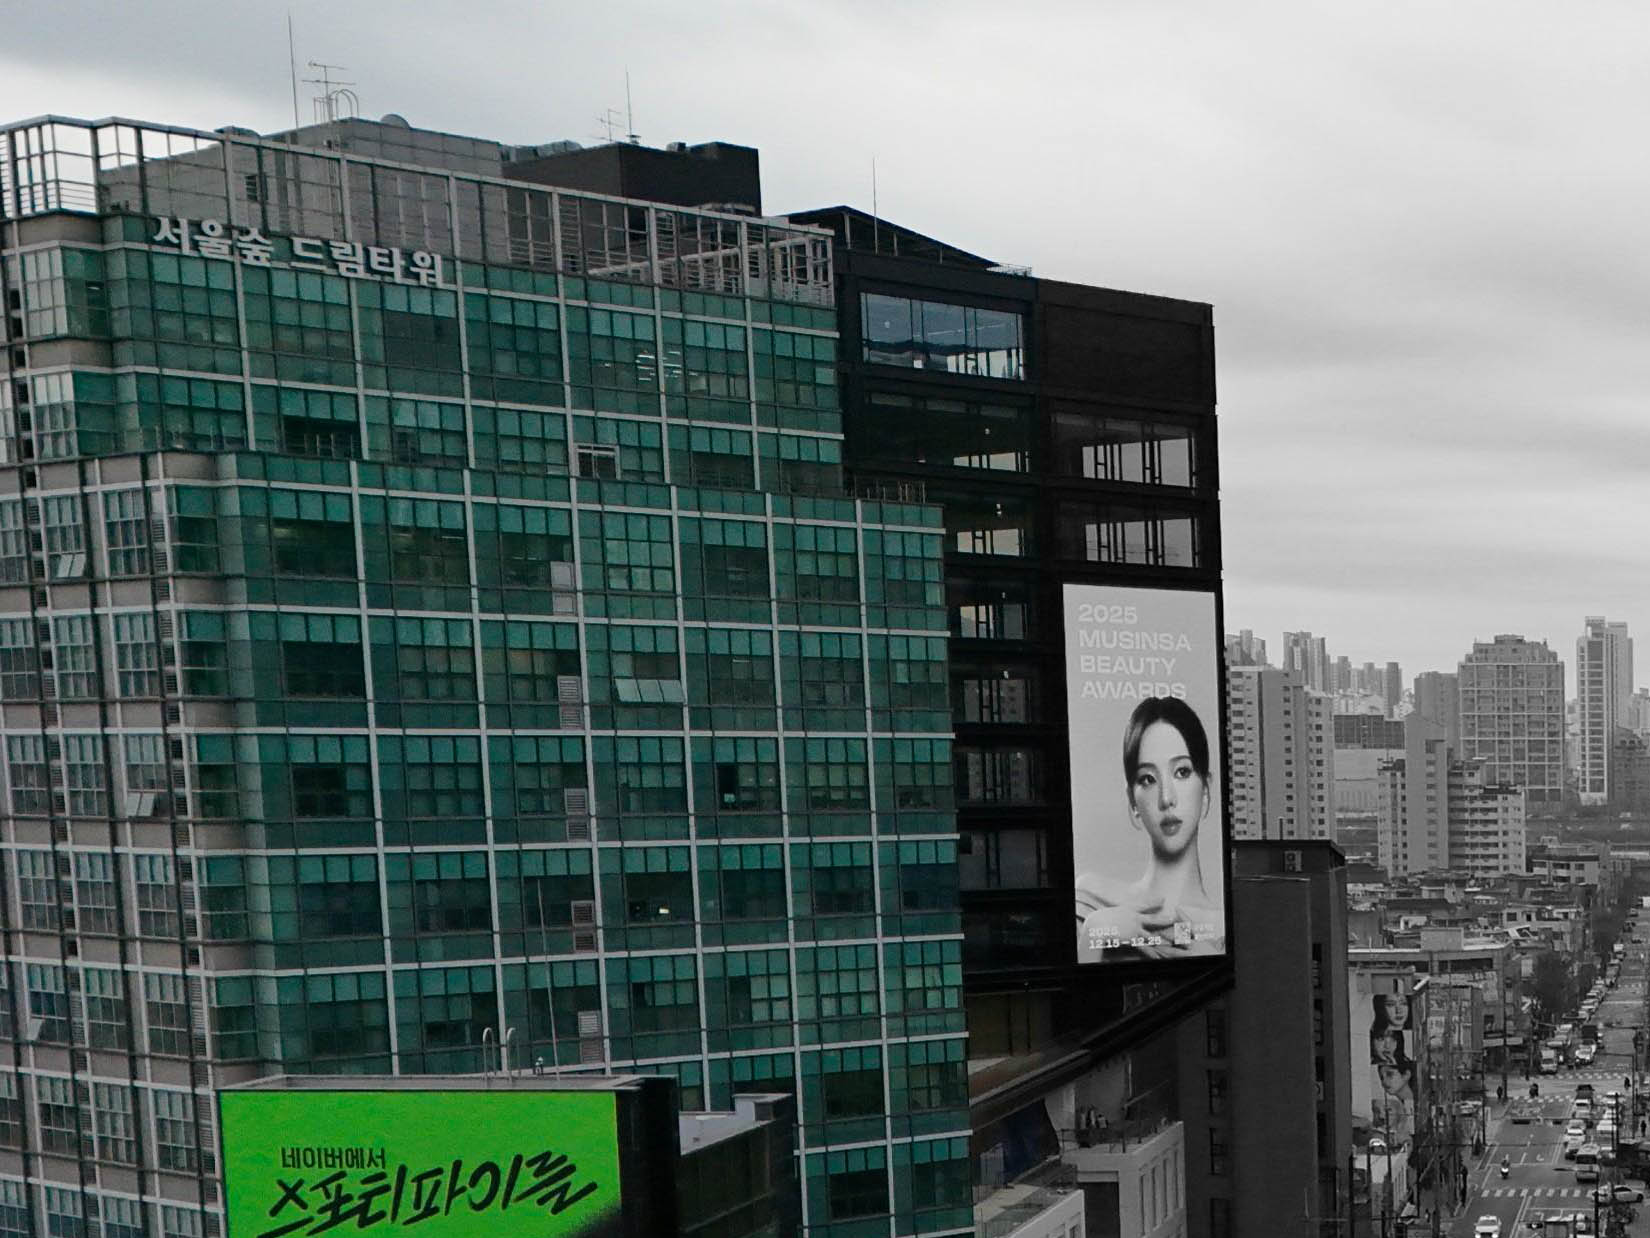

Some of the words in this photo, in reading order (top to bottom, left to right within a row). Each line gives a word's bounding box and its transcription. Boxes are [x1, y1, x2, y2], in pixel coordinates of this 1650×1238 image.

[153, 216, 274, 267] 서울숲
[290, 236, 443, 288] 드림타워
[1078, 604, 1138, 625] 2025
[1079, 629, 1192, 652] MUSINSA
[1080, 655, 1176, 676] BEAUTY
[1081, 680, 1187, 700] AWARDS
[281, 1146, 386, 1170] 네이버에서
